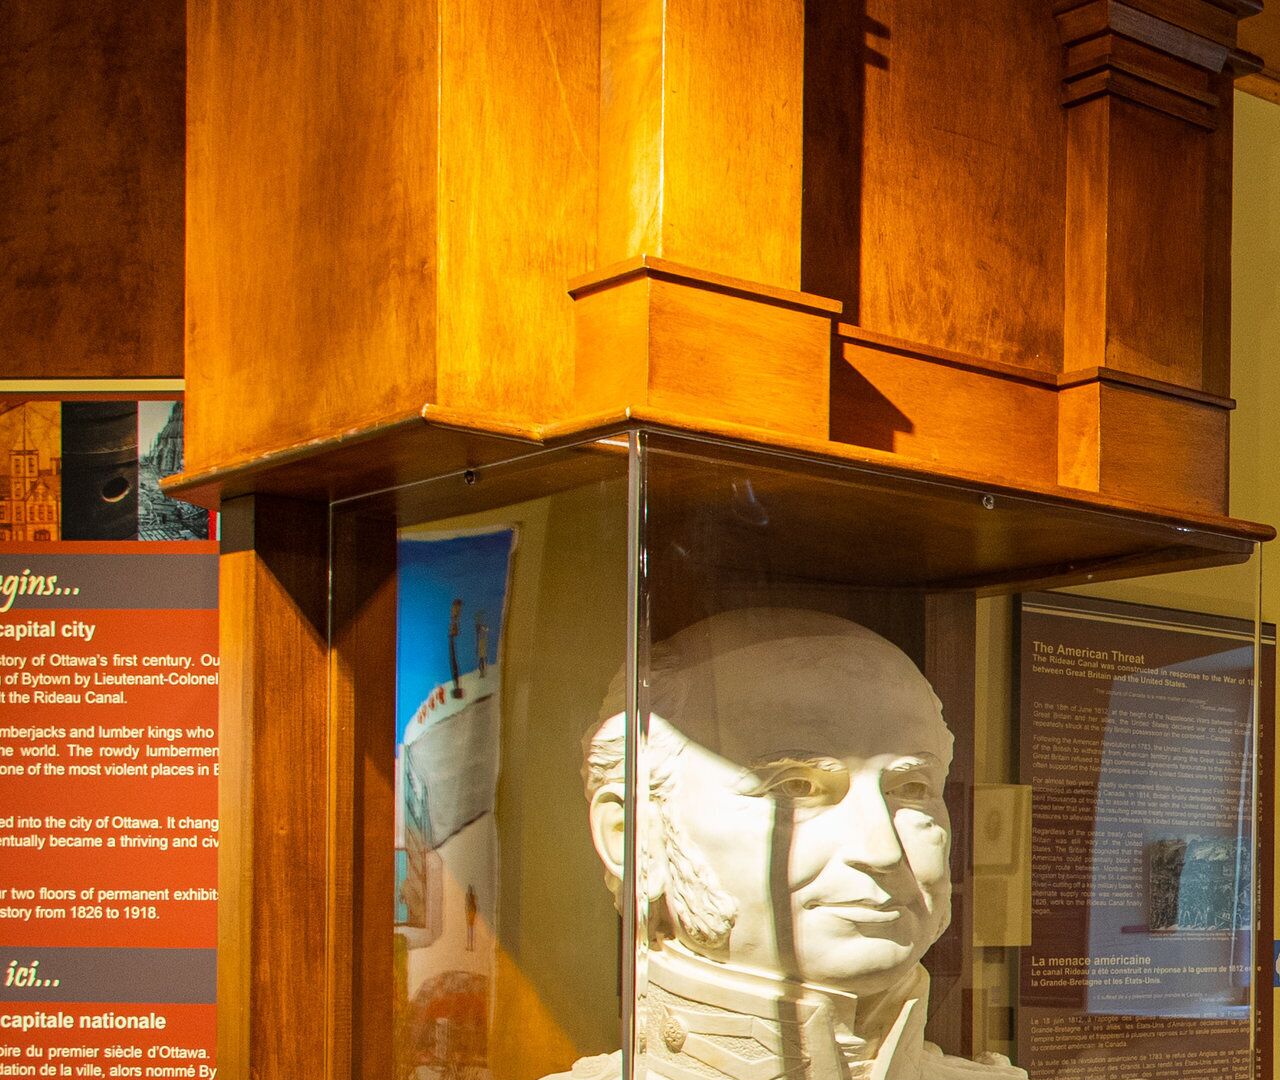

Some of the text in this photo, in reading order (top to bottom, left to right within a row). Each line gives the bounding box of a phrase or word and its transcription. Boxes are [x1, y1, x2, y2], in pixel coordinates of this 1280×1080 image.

[61, 621, 96, 641] city
[1033, 641, 1145, 664] The American Threat
[49, 654, 195, 669] Ottawa's first century.
[1033, 654, 1047, 662] The
[1050, 656, 1075, 665] Rideau
[1117, 664, 1158, 675] constructed
[1170, 672, 1200, 680] response
[1211, 674, 1221, 682] the
[1224, 676, 1236, 684] War
[1239, 677, 1244, 685] of
[22, 672, 219, 688] Bytown Lieutenant-Colonel
[1033, 665, 1064, 675] between
[1066, 668, 1086, 677] Great
[1088, 670, 1111, 680] Britain
[1128, 675, 1139, 683] the
[1141, 676, 1162, 685] United
[1165, 678, 1187, 688] States.
[8, 691, 127, 704] the Rideau Canal.
[69, 726, 95, 738] and
[99, 726, 145, 738] lumber
[148, 726, 183, 741] kings
[186, 726, 214, 738] who
[20, 744, 219, 760] world. The rowdy lumbermen
[0, 763, 194, 778] one the most violent places
[17, 815, 162, 831] into the city Ottawa.
[49, 834, 197, 850] became thriving and
[11, 887, 169, 903] two floors permanent
[35, 905, 159, 919] from 1826 1918.
[1032, 954, 1151, 966] La menace américaine
[5, 960, 60, 987] ici...
[1032, 968, 1040, 976] Le
[1043, 968, 1062, 976] canal
[1154, 966, 1181, 975] réponse
[1196, 967, 1217, 975] guerre
[1040, 978, 1102, 987] Grande-Bretagne
[1, 1012, 166, 1032] capitale nationale
[48, 1044, 210, 1060] premier siècle d'Ottawa.
[76, 1064, 196, 1078] ville, alors nommé
